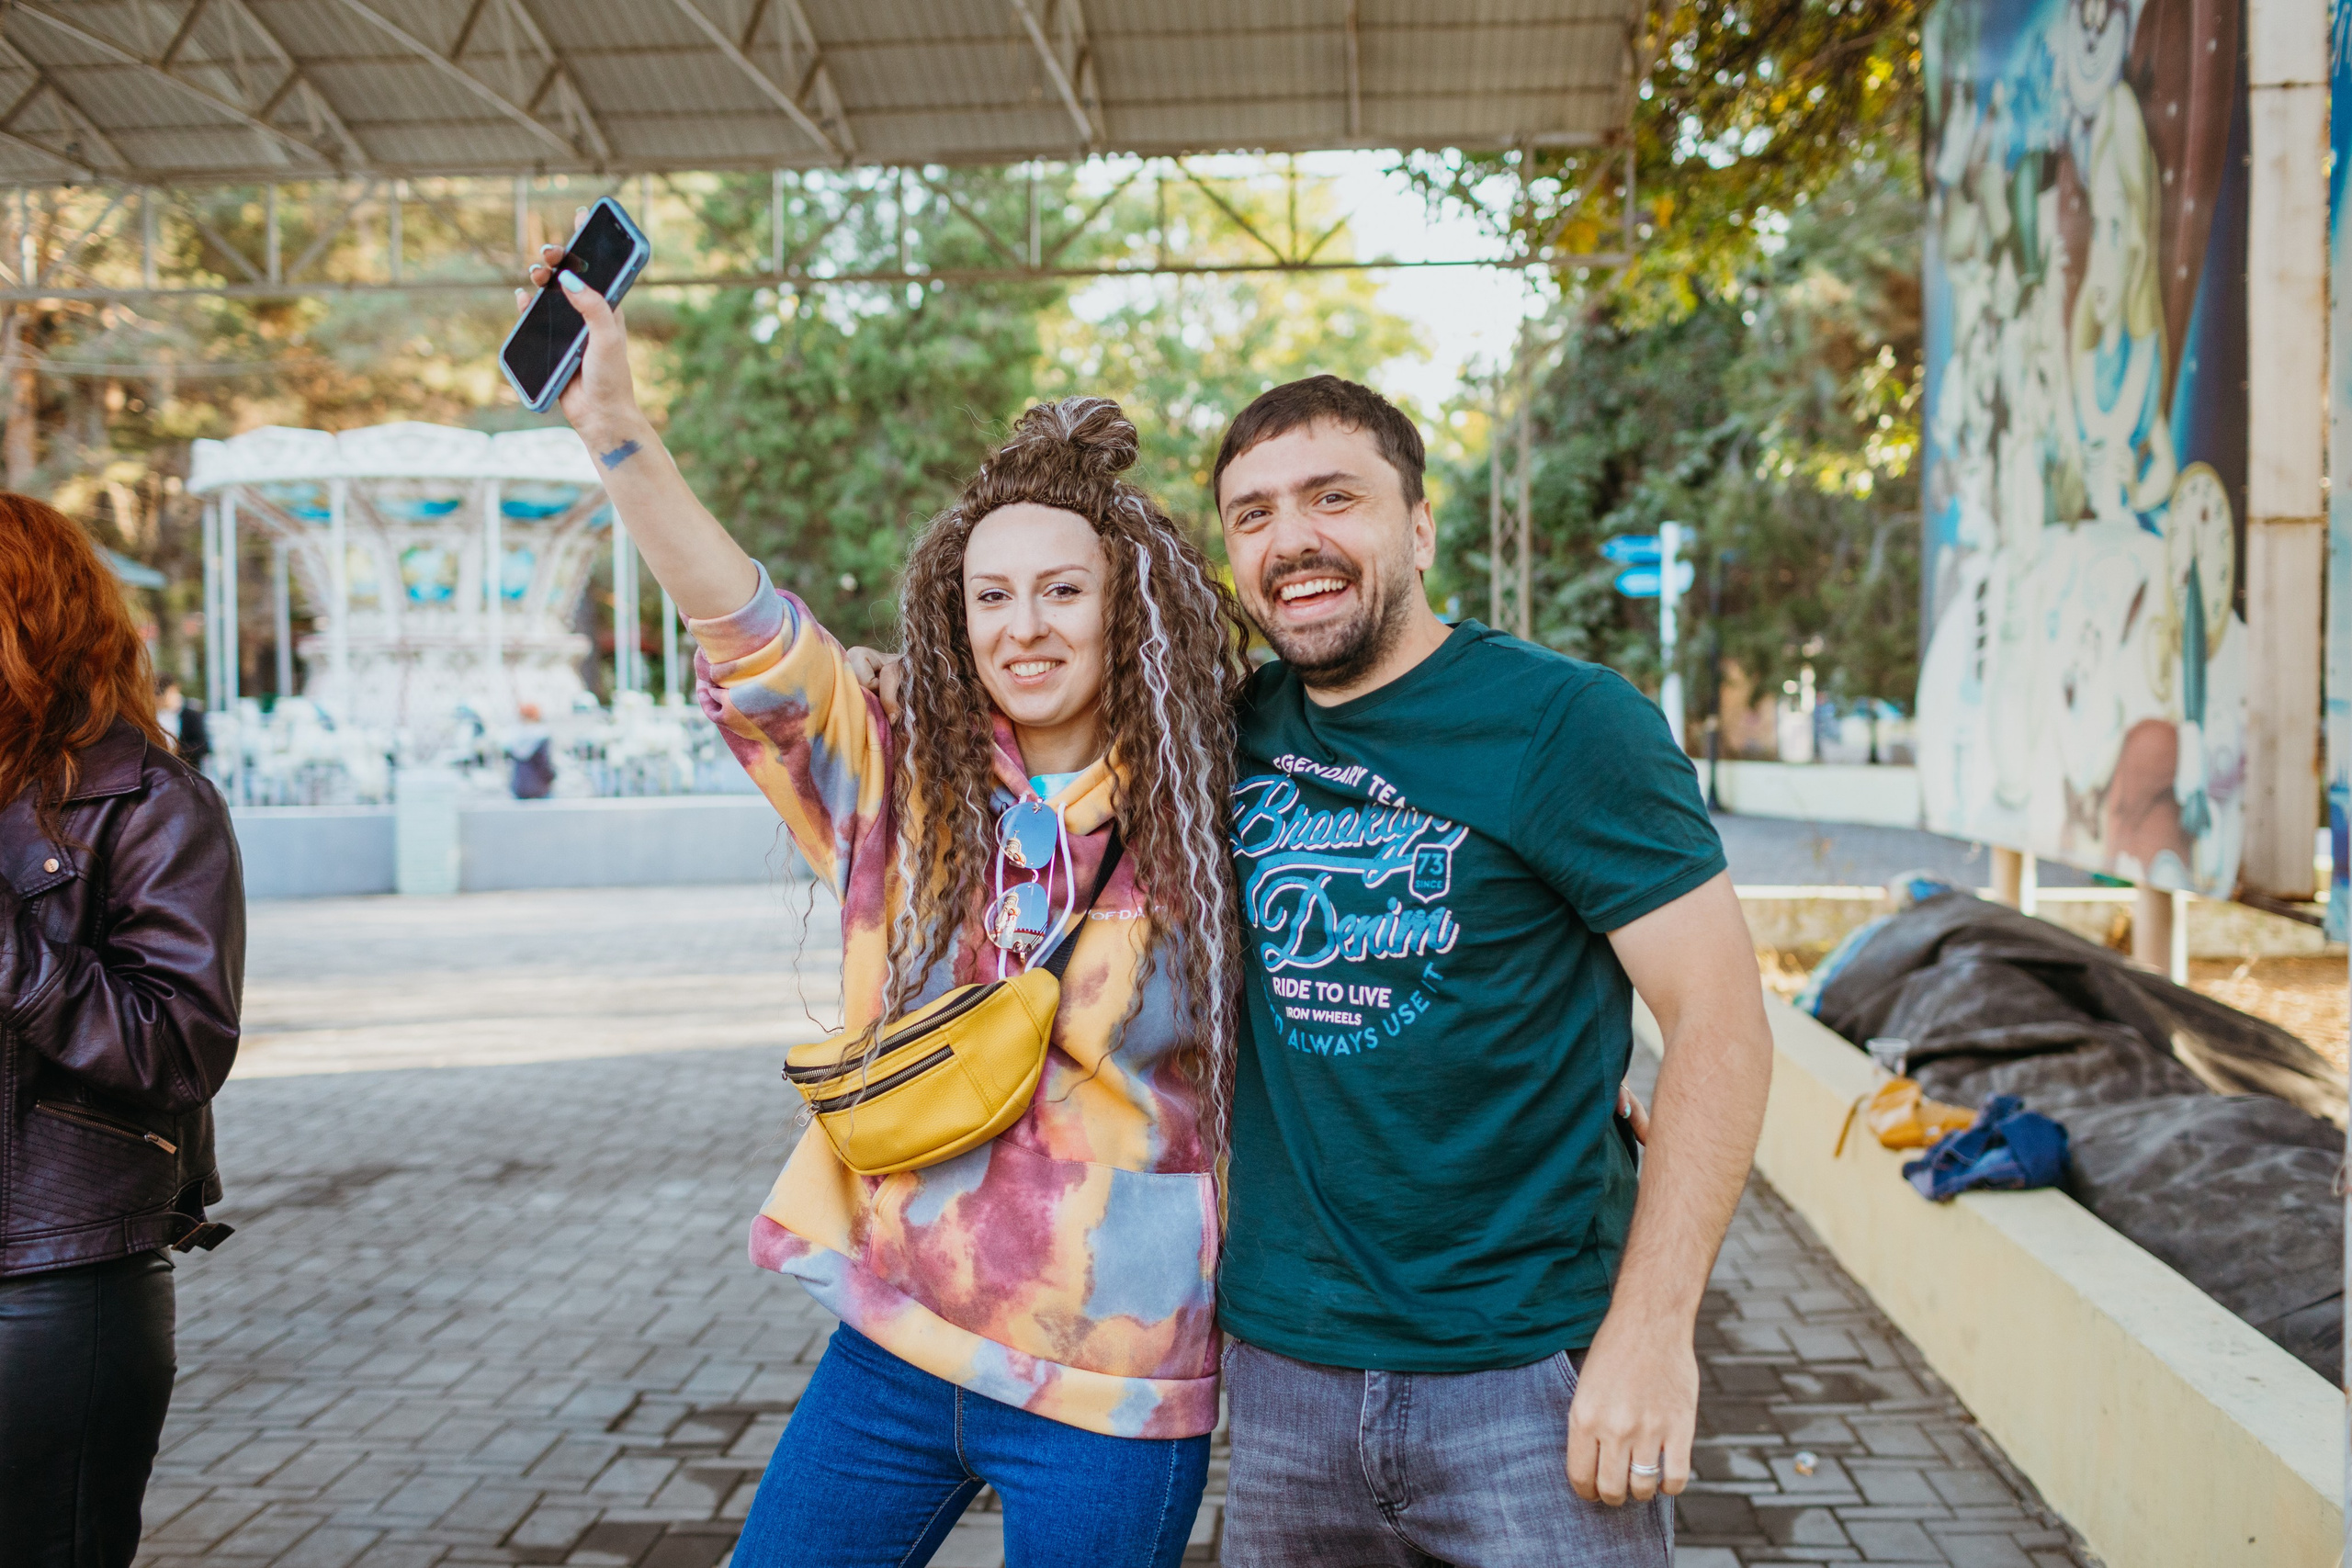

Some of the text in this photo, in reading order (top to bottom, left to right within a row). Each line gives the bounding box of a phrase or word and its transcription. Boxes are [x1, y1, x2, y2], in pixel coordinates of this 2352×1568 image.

[1273, 753, 1407, 809] EGENDARY TEA
[1417, 852, 1445, 875] 73
[1415, 879, 1443, 889] SINCE
[1091, 910, 1116, 921] OF
[1259, 872, 1460, 973] Denim
[1272, 976, 1392, 1009] RIDE TO LIVE
[1285, 1006, 1363, 1026] IRON WHEELS
[1287, 962, 1444, 1056] ALWAYS USE IT
